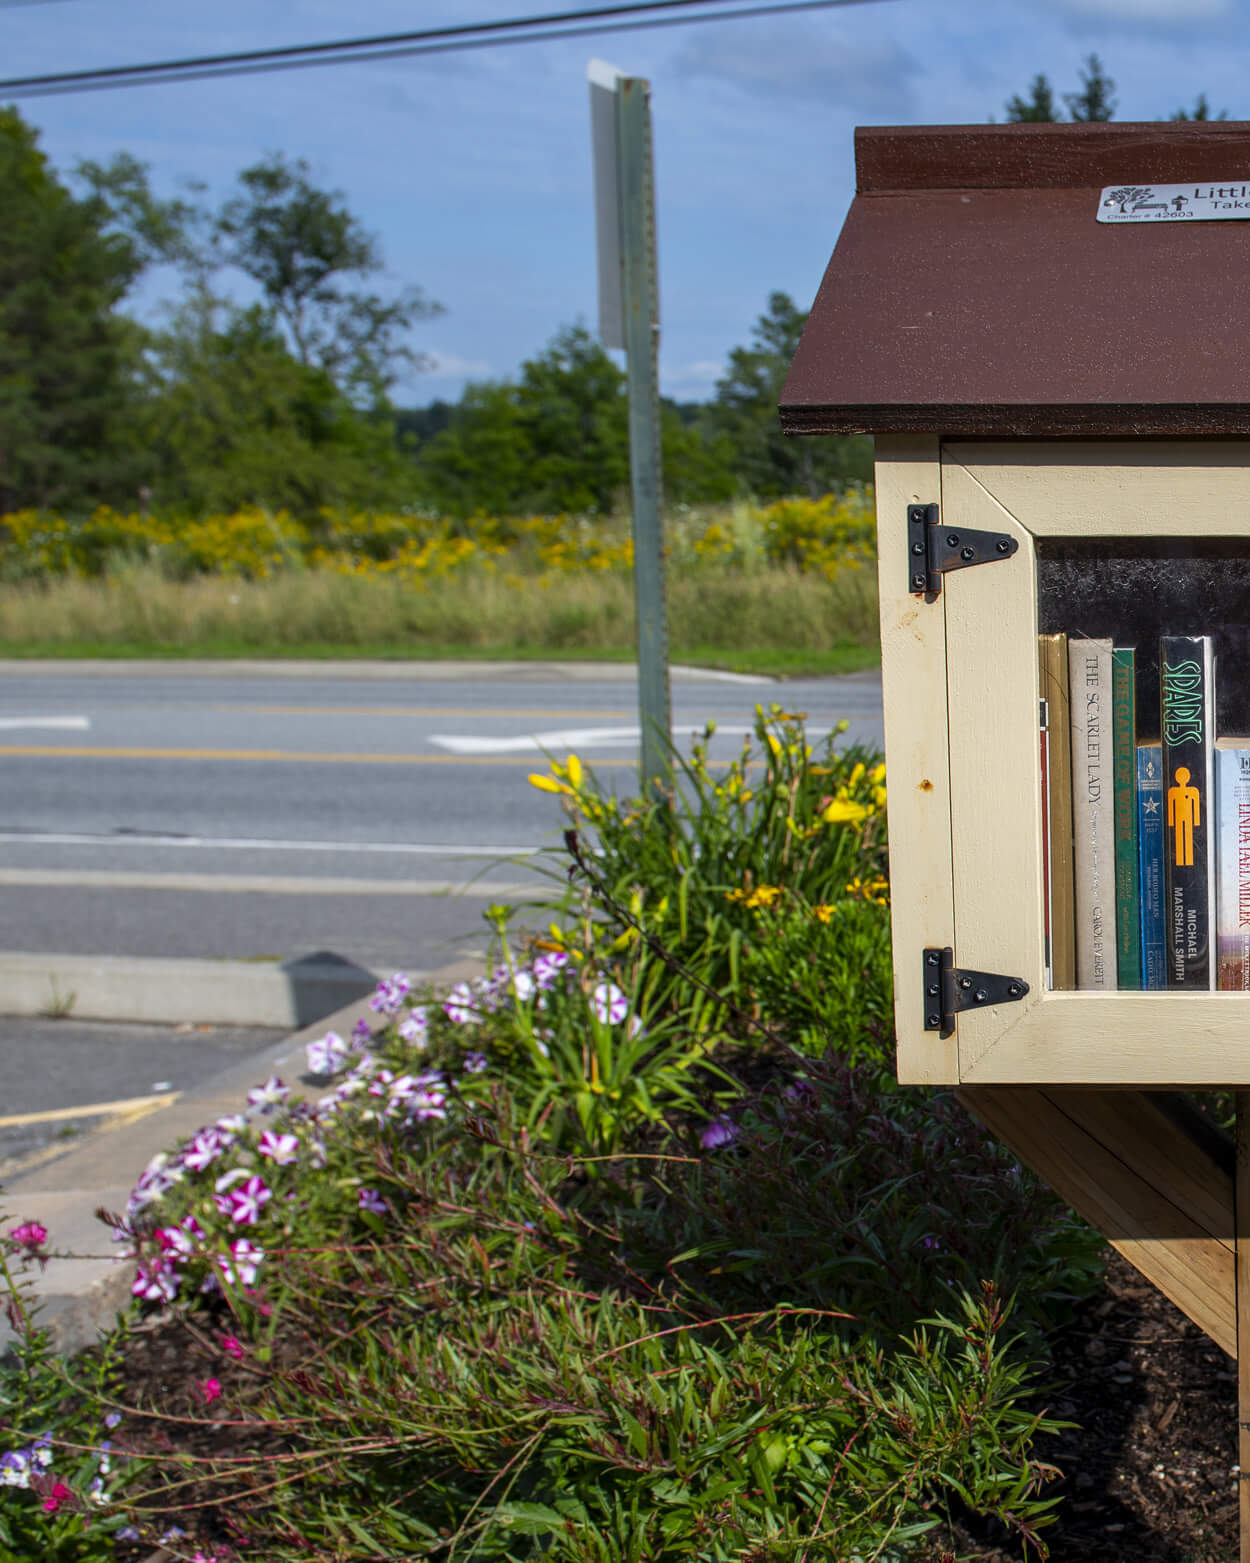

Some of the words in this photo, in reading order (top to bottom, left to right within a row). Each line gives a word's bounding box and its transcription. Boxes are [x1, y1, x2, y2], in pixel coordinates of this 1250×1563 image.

[1086, 655, 1099, 687] THE
[1116, 666, 1130, 701] THE
[1162, 660, 1203, 747] SPARES
[1086, 692, 1100, 761] SCARLET
[1116, 703, 1130, 758] GAME
[1087, 764, 1101, 807] LADY
[1117, 759, 1130, 784] OF
[1118, 788, 1131, 841] WORK
[1092, 906, 1103, 939] CAROL
[1173, 887, 1184, 945] MARSHALL
[1187, 909, 1197, 959] MICHAEL
[1093, 942, 1105, 985] EVERETT
[1175, 947, 1185, 981] SMITH
